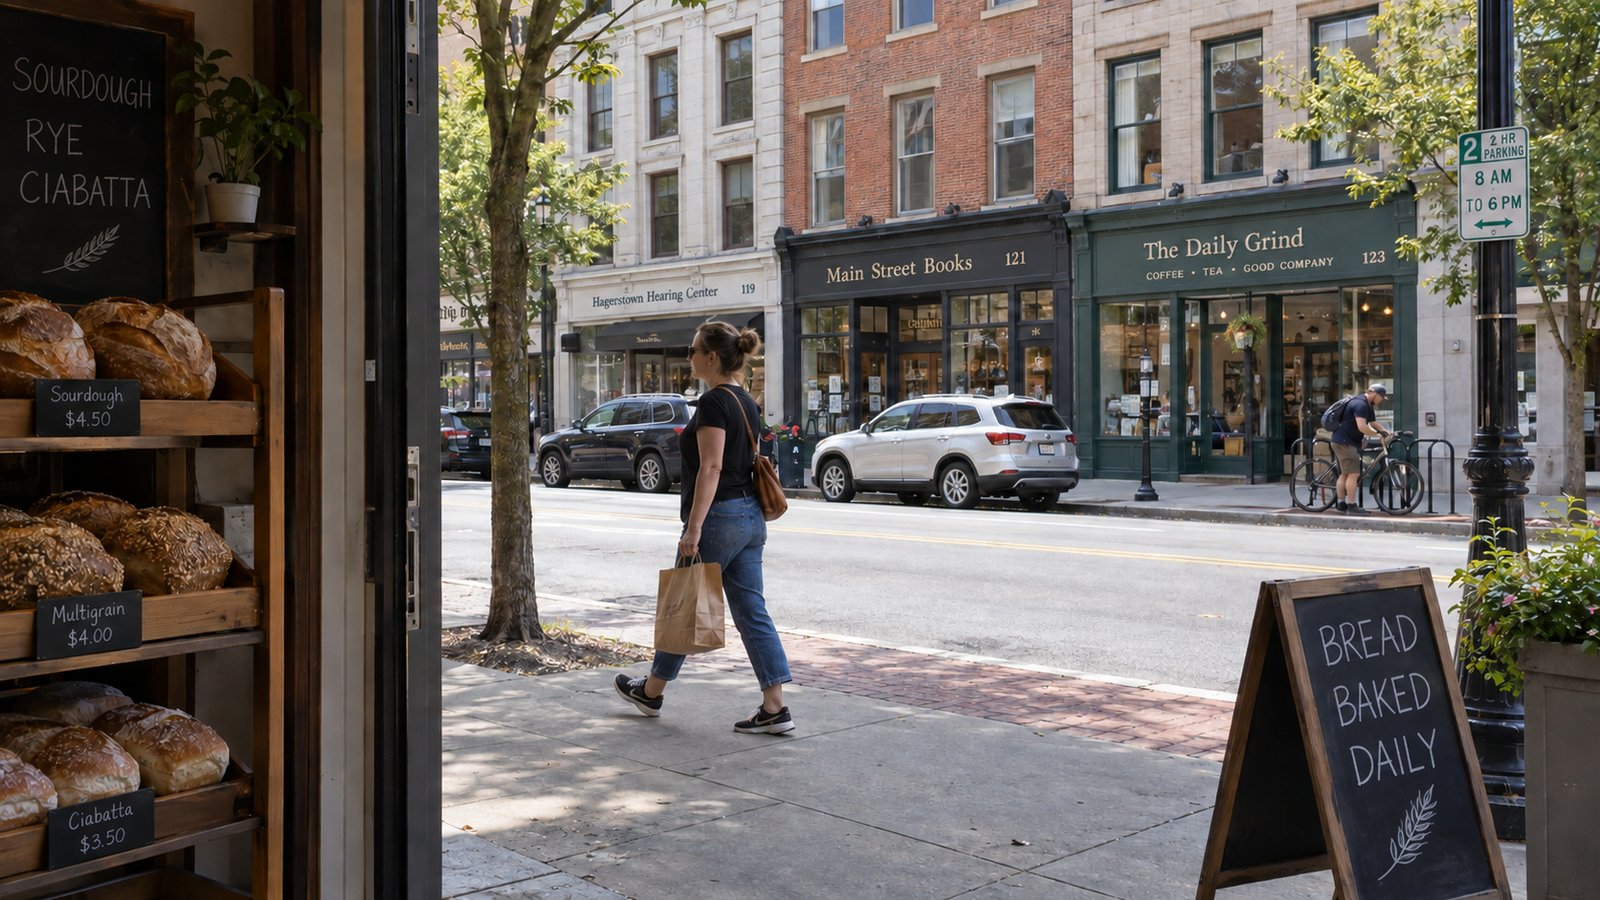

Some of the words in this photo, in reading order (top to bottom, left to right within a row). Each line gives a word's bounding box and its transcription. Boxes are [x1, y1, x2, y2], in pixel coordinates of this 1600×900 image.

[12, 57, 152, 109] SOURDOUGH
[25, 118, 83, 155] RYE
[1490, 135, 1497, 146] 2
[1501, 133, 1516, 144] HR
[1463, 137, 1478, 161] 2
[1484, 145, 1524, 159] PARKING
[1475, 171, 1484, 185] 8
[1490, 168, 1512, 184] AM
[19, 171, 151, 209] CIABATTA
[1466, 199, 1482, 212] TO
[1488, 197, 1497, 210] 6
[1502, 195, 1521, 209] PM
[1143, 240, 1179, 261] The
[1186, 235, 1239, 259] Daily
[1244, 227, 1303, 252] Grind
[826, 266, 864, 284] Main
[871, 261, 916, 279] Street
[924, 253, 973, 274] Books
[1005, 251, 1026, 265] 121
[1146, 269, 1184, 281] COFFEE
[1203, 267, 1223, 277] TEA
[1243, 262, 1275, 273] GOOD
[1280, 257, 1334, 271] COMPANY
[1362, 250, 1386, 265] 123
[592, 294, 643, 309] Hagerstown
[647, 289, 682, 304] Hearing
[686, 286, 719, 299] Center
[741, 283, 756, 295] 119
[50, 385, 124, 409] Sourdough
[65, 410, 111, 428] $4.50
[52, 602, 125, 627] Multigrain
[67, 627, 112, 648] $4.00
[1318, 614, 1418, 667] BREAD
[1333, 672, 1432, 727] BAKED
[1349, 728, 1437, 787] DAILY
[69, 802, 133, 829] Ciabatta
[80, 828, 126, 854] $3.50
